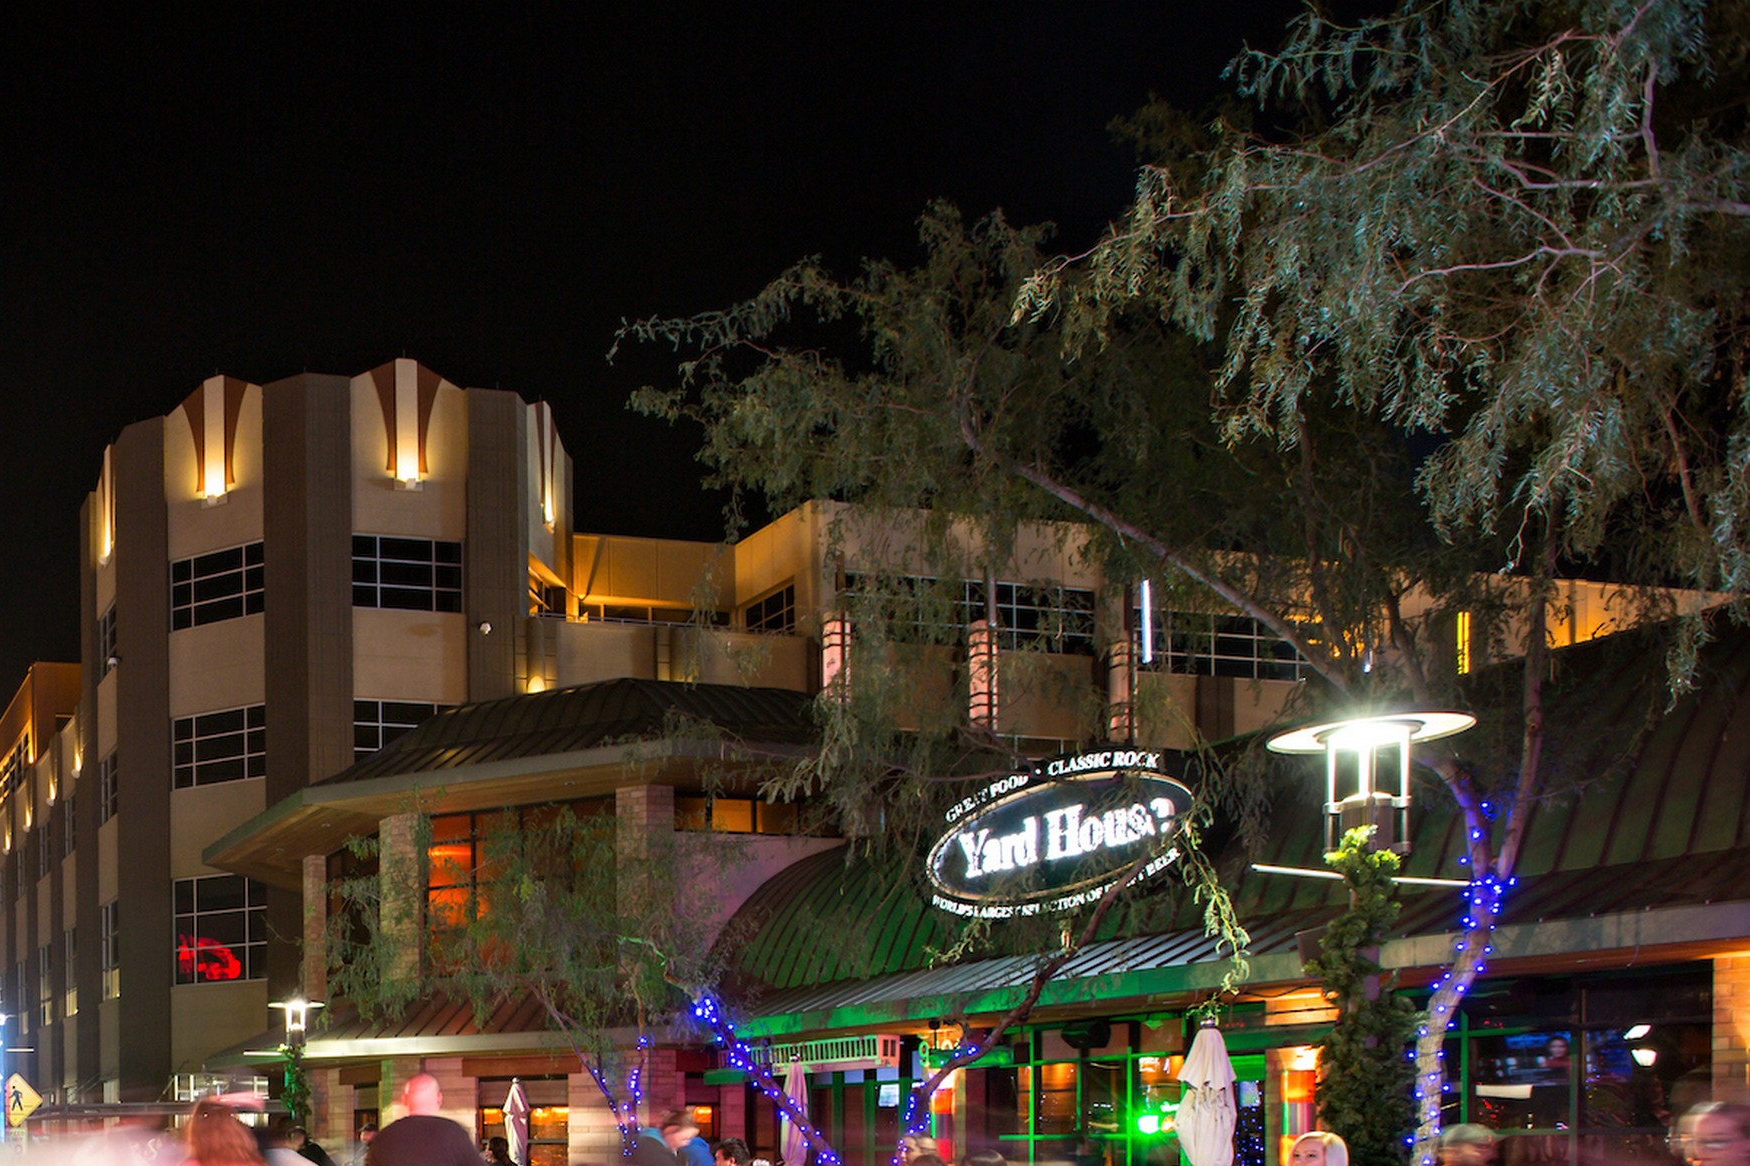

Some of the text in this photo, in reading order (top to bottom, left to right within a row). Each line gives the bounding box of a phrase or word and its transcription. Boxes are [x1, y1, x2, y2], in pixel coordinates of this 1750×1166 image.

[990, 775, 1028, 799] FOOD
[1047, 752, 1112, 776] CLASSIC
[1112, 751, 1159, 769] ROCK
[958, 815, 1041, 880] Yard
[1021, 892, 1085, 916] SELCTION
[1086, 886, 1103, 902] OF
[1145, 847, 1181, 877] BEER
